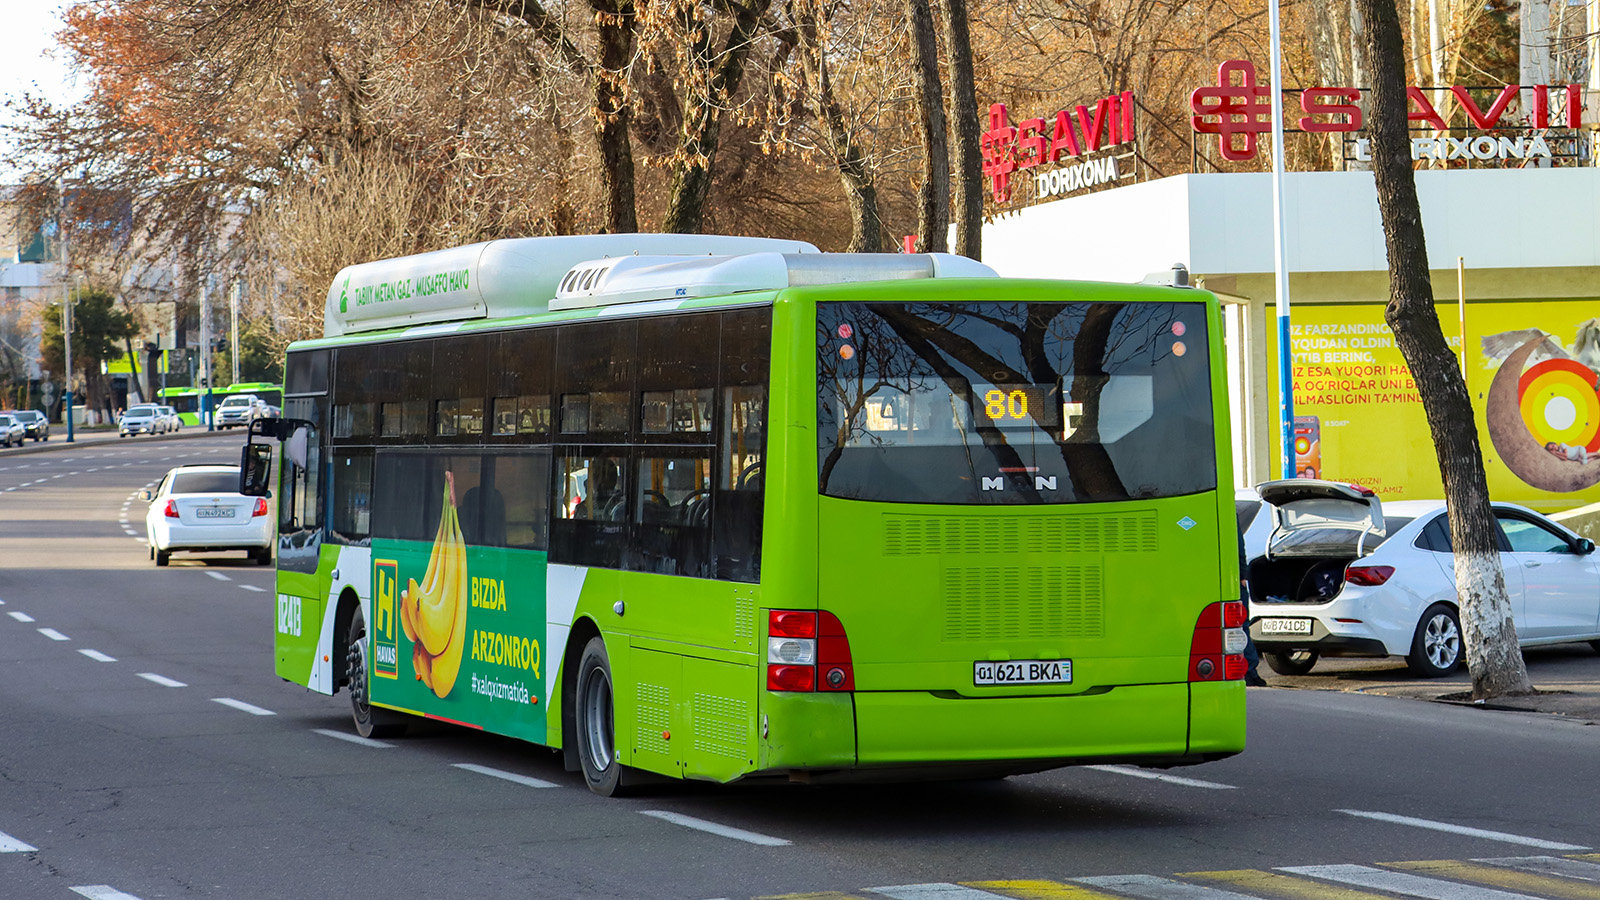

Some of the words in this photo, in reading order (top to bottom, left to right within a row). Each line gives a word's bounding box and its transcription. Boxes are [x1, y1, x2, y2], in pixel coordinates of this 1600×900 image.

[1019, 91, 1135, 169] SAVII
[1356, 136, 1552, 161] DRIXONA
[1038, 156, 1120, 198] DORIXONA
[375, 281, 396, 302] METAN
[397, 279, 411, 300] GAZ
[416, 272, 447, 296] MUSAFFO
[449, 268, 469, 291] HAVO
[1290, 325, 1302, 335] IZ
[1292, 338, 1347, 351] YQUDAN
[1350, 337, 1391, 348] OLDIN
[1292, 352, 1321, 363] YTIB
[1324, 351, 1376, 364] BERING,
[1293, 367, 1304, 377] IZ
[1308, 366, 1332, 377] ESA
[1336, 365, 1386, 377] YUQORI
[1380, 379, 1402, 390] UNI
[985, 390, 1027, 419] 80
[1294, 393, 1371, 405] ILMASLIGINI
[1374, 393, 1424, 403] TA'MINL
[471, 576, 507, 611] BIZDA
[376, 645, 396, 664] HAVAS
[471, 629, 540, 680] ARZONROQ
[471, 672, 529, 704] #xalqxizmatida
